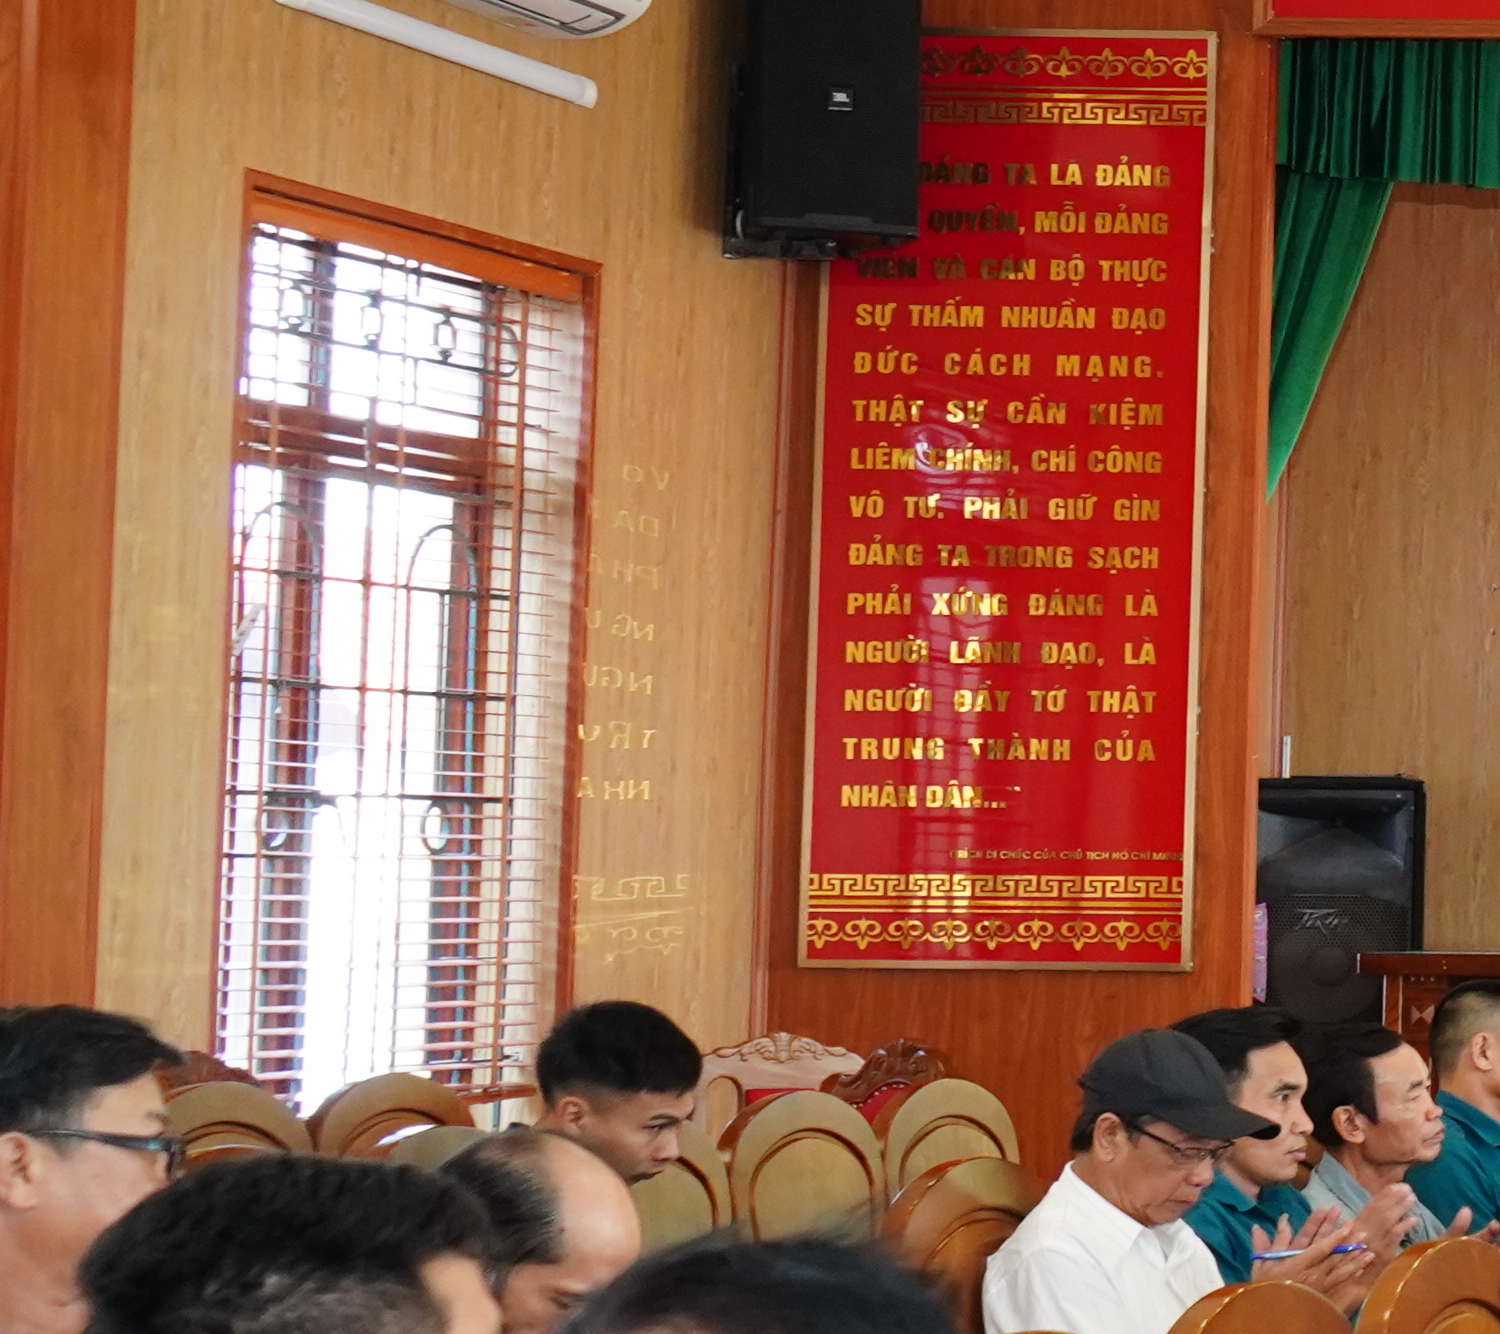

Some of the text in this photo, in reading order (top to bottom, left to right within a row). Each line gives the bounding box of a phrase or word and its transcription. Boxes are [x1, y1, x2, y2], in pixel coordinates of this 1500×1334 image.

[1005, 163, 1037, 185] TA
[1095, 155, 1171, 187] ĐẢNG
[1034, 201, 1086, 233] MỖI
[1095, 204, 1169, 235] ĐẢNG
[932, 253, 967, 279] VÀ
[980, 253, 1036, 280] CÁN
[1050, 254, 1085, 287] BỘ
[1099, 258, 1168, 287] THỰC
[855, 296, 1166, 334] SỰ THẤM NHUẦN ĐẠO
[853, 346, 919, 374] ĐỨC
[944, 347, 1030, 376] CÁCH
[853, 393, 1164, 430] THẬT SỰ CẦN KIỆM
[850, 442, 1162, 474] LIÊM CHÍNH, CHÍ CÔNG
[850, 490, 884, 518] VÔ
[964, 488, 1028, 519] PHẢI
[1048, 493, 1097, 520] GIỮ
[1114, 493, 1160, 521] GÌN
[848, 534, 1159, 573] ĐẢNG TA TRONG SẠCH
[846, 584, 1158, 617] PHẢI XỨNG ĐÁNG LÀ
[845, 634, 1157, 669] NGƯỜI LÃNH ĐẠO, LÀ
[844, 683, 932, 712] NGƯỜI
[1032, 684, 1068, 712] TỚ
[1087, 686, 1157, 718] THẬT
[842, 731, 1156, 761] TRUNG THÀNH CỦA
[841, 779, 918, 807] NHÂN
